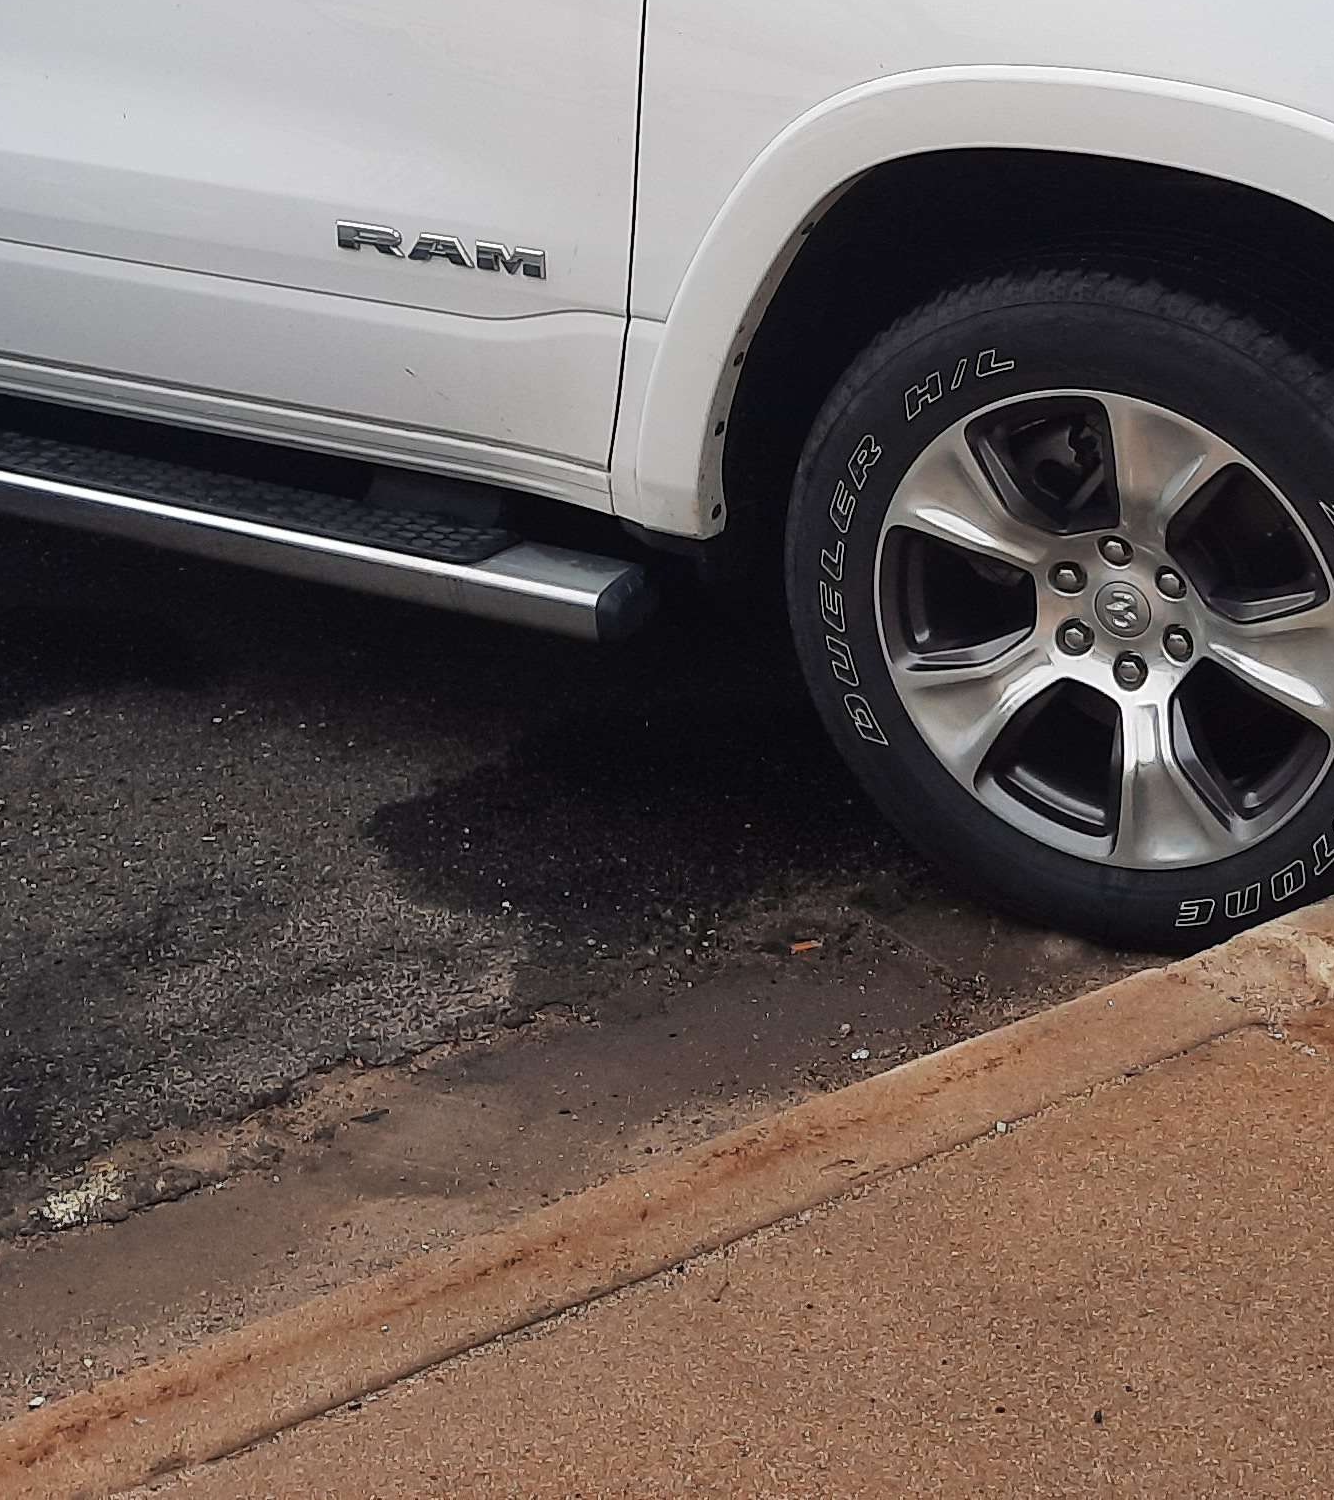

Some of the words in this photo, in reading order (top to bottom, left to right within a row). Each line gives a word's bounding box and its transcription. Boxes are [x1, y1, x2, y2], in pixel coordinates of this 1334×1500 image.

[334, 218, 548, 280] RAM
[816, 433, 889, 748] DUELER
[903, 347, 1016, 422] H/L
